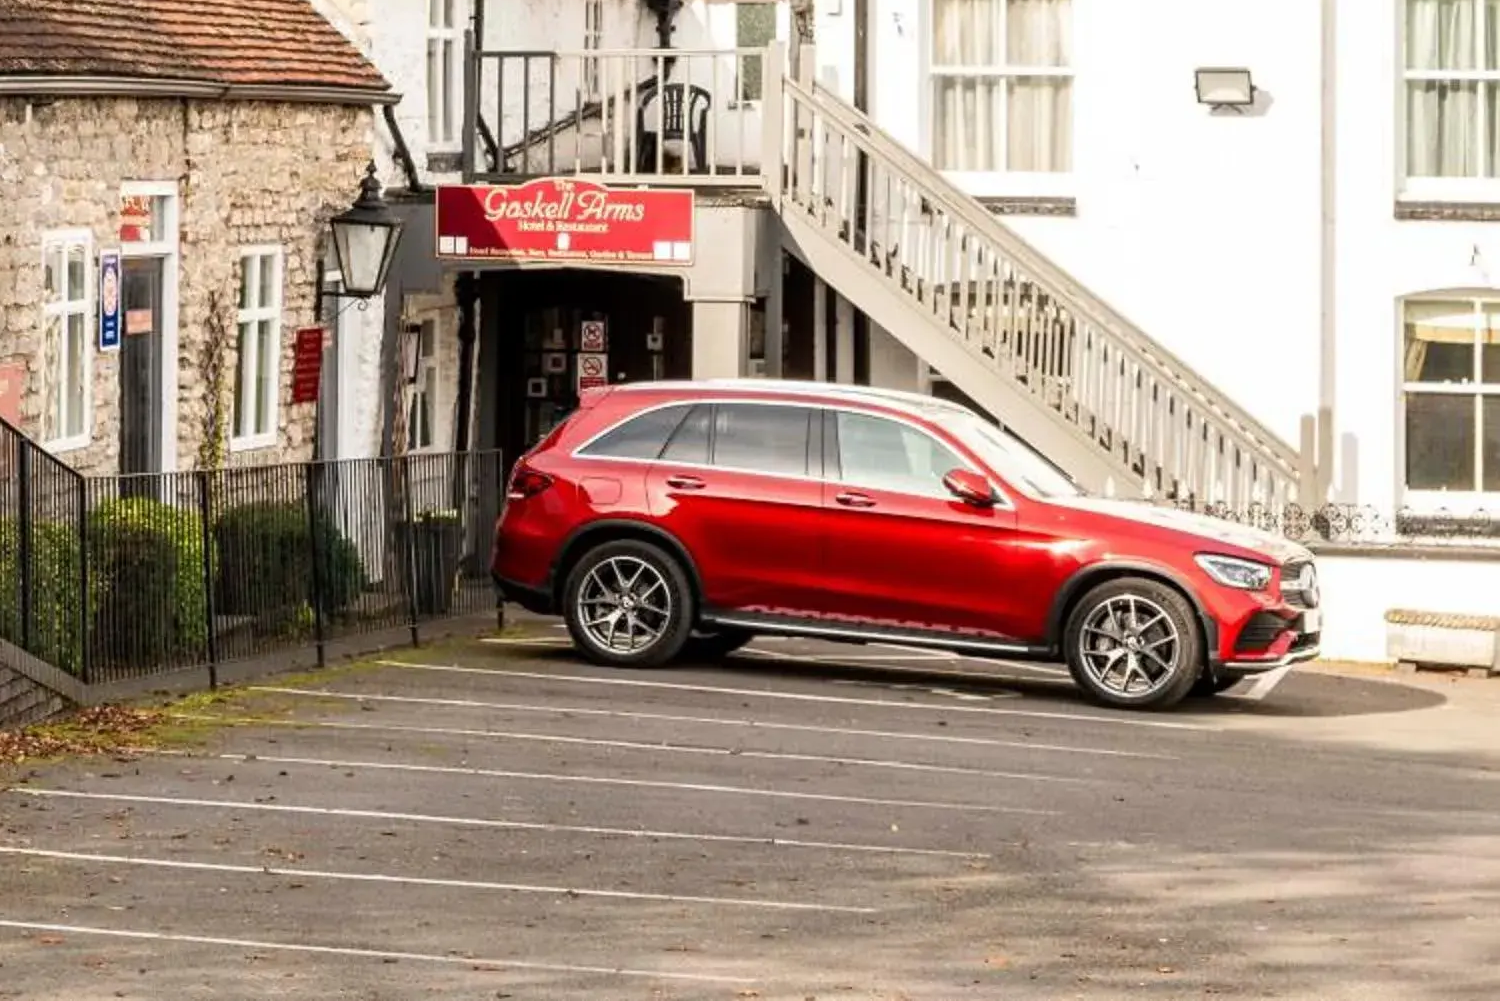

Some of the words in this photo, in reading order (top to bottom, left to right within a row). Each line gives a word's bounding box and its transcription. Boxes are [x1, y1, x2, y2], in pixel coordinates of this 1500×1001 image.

[484, 188, 575, 221] Gaskell
[576, 190, 645, 222] Arms
[517, 219, 544, 232] Hotel
